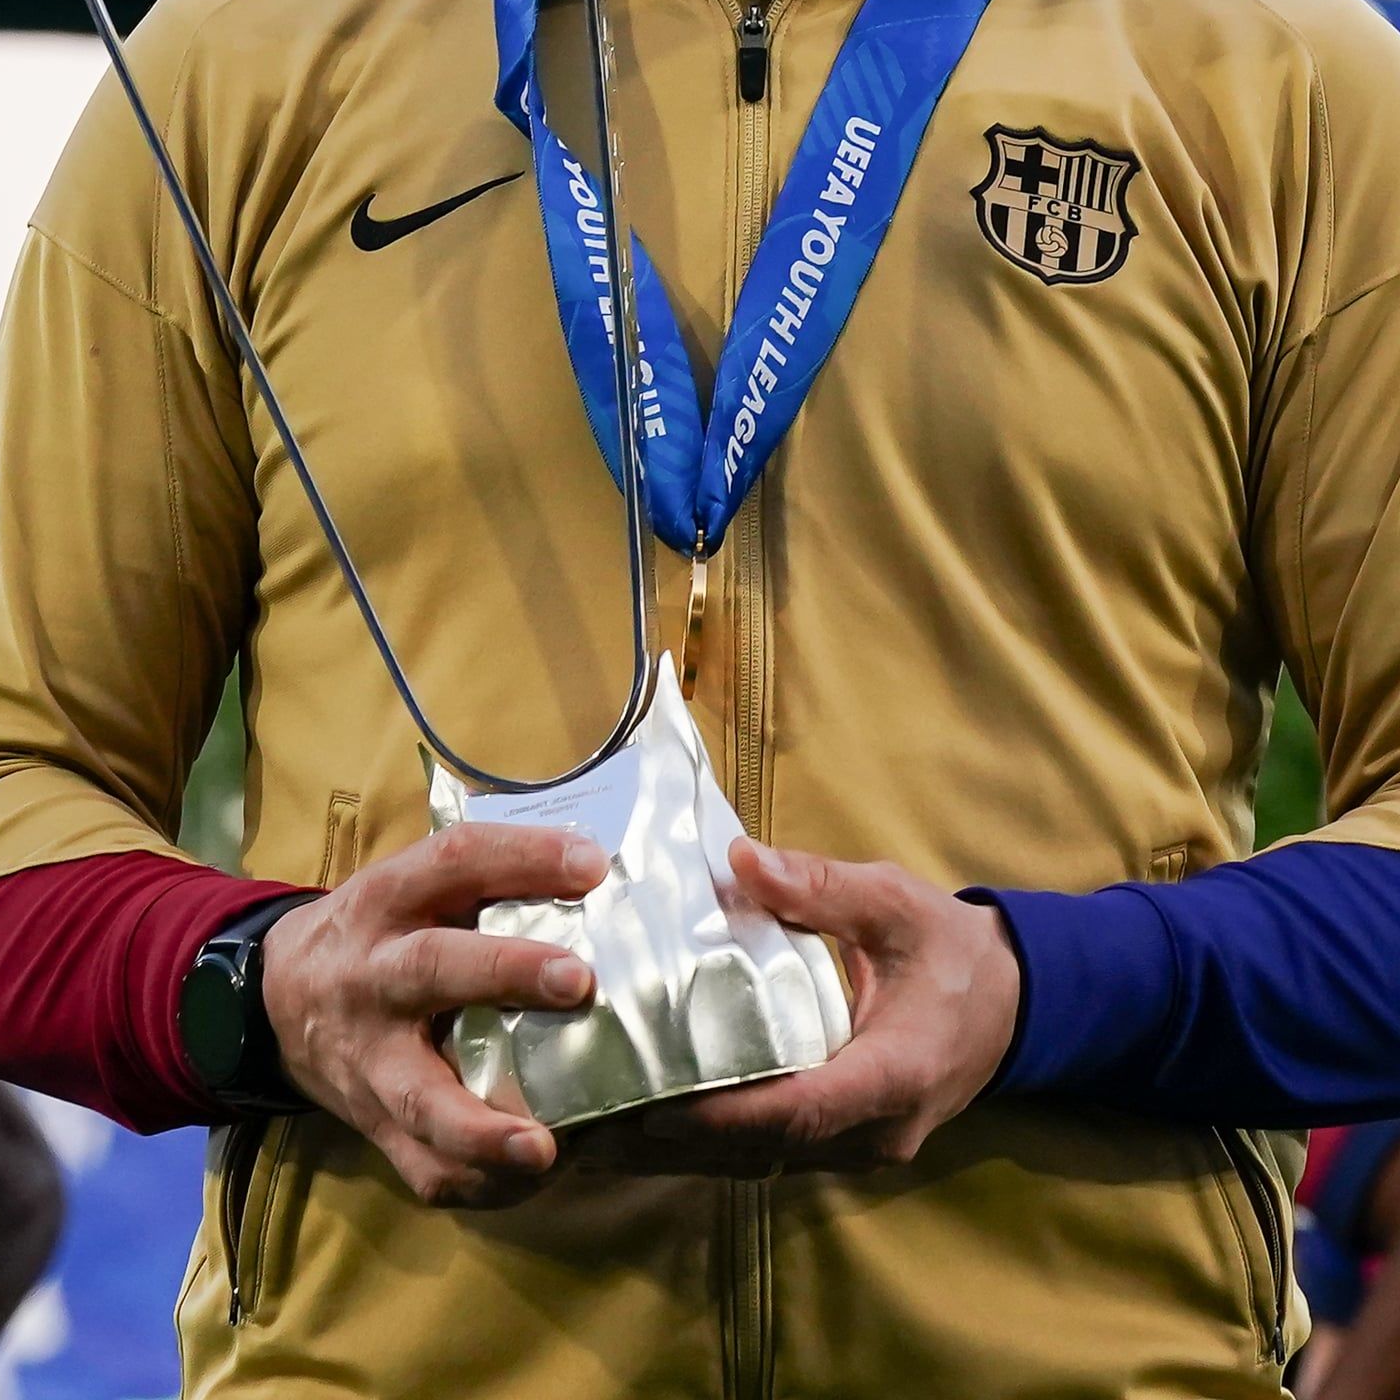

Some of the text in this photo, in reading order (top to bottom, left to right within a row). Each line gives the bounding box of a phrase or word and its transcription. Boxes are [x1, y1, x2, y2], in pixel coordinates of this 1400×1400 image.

[819, 116, 881, 206] UEFA
[1028, 195, 1083, 222] FCB
[769, 209, 847, 345] YOUTH
